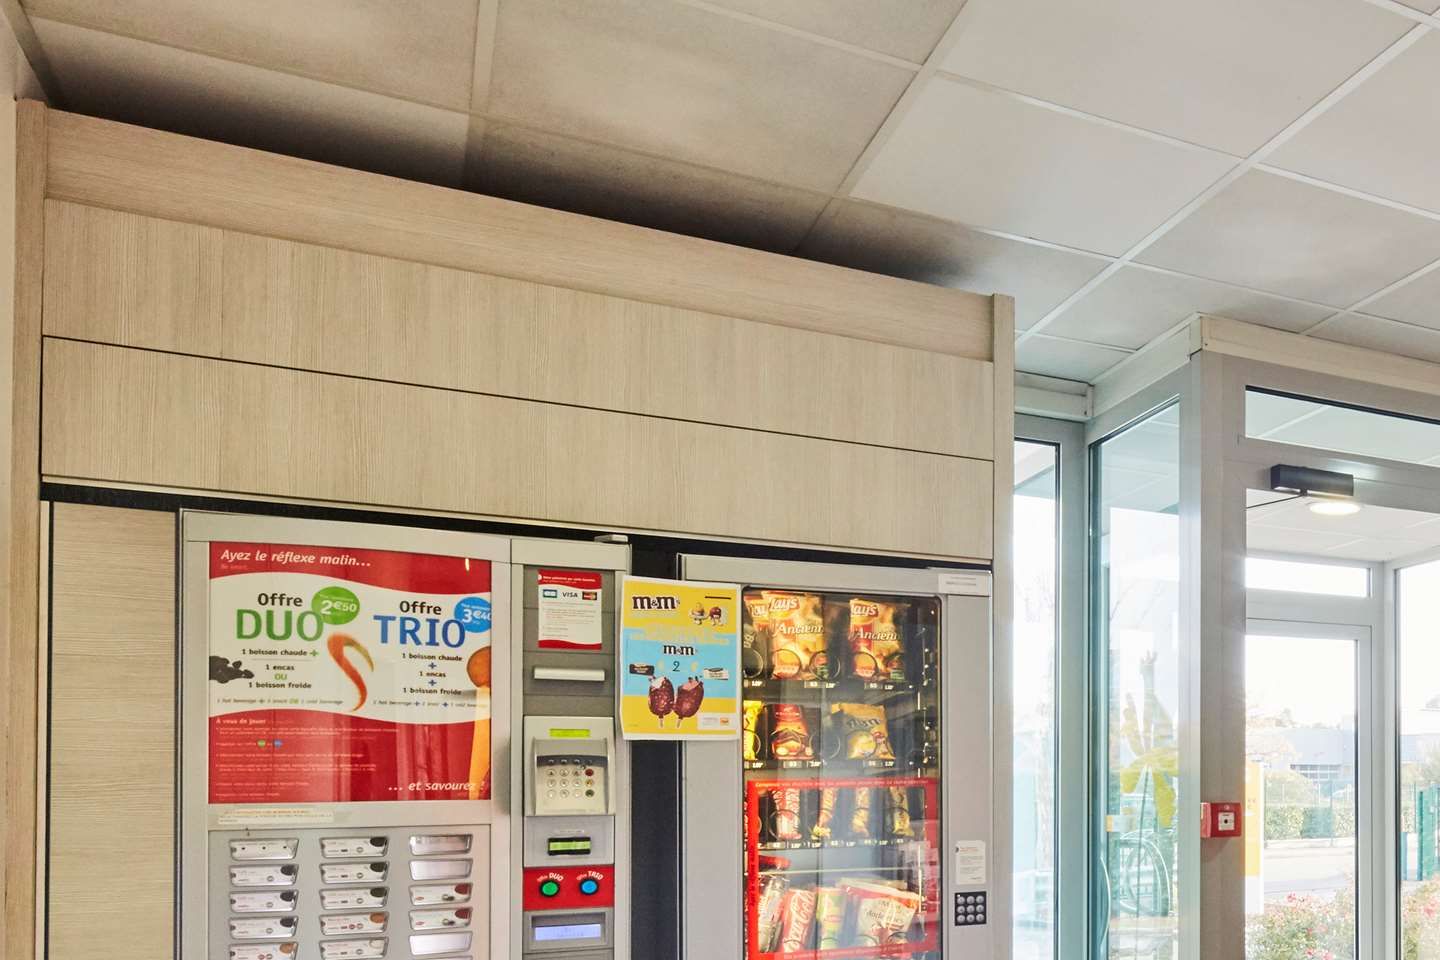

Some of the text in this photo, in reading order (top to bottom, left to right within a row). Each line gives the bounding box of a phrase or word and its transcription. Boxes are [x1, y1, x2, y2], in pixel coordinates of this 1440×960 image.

[221, 549, 251, 562] Ayez
[255, 550, 267, 561] le
[271, 551, 316, 566] réflexe
[257, 592, 303, 607] Offre
[320, 600, 357, 615] 2€50
[399, 600, 442, 615] Offre
[235, 608, 324, 641] DUO
[373, 615, 466, 648] TRIO
[249, 648, 278, 656] boisson
[408, 653, 438, 661] boisson
[672, 661, 681, 672] 2
[274, 673, 288, 681] OU
[255, 681, 286, 689] boisson
[409, 687, 438, 696] boisson
[440, 689, 462, 697] froide
[408, 782, 421, 791] et
[425, 781, 475, 791] savourez
[549, 872, 564, 881] DUO
[587, 871, 604, 880] TRIO
